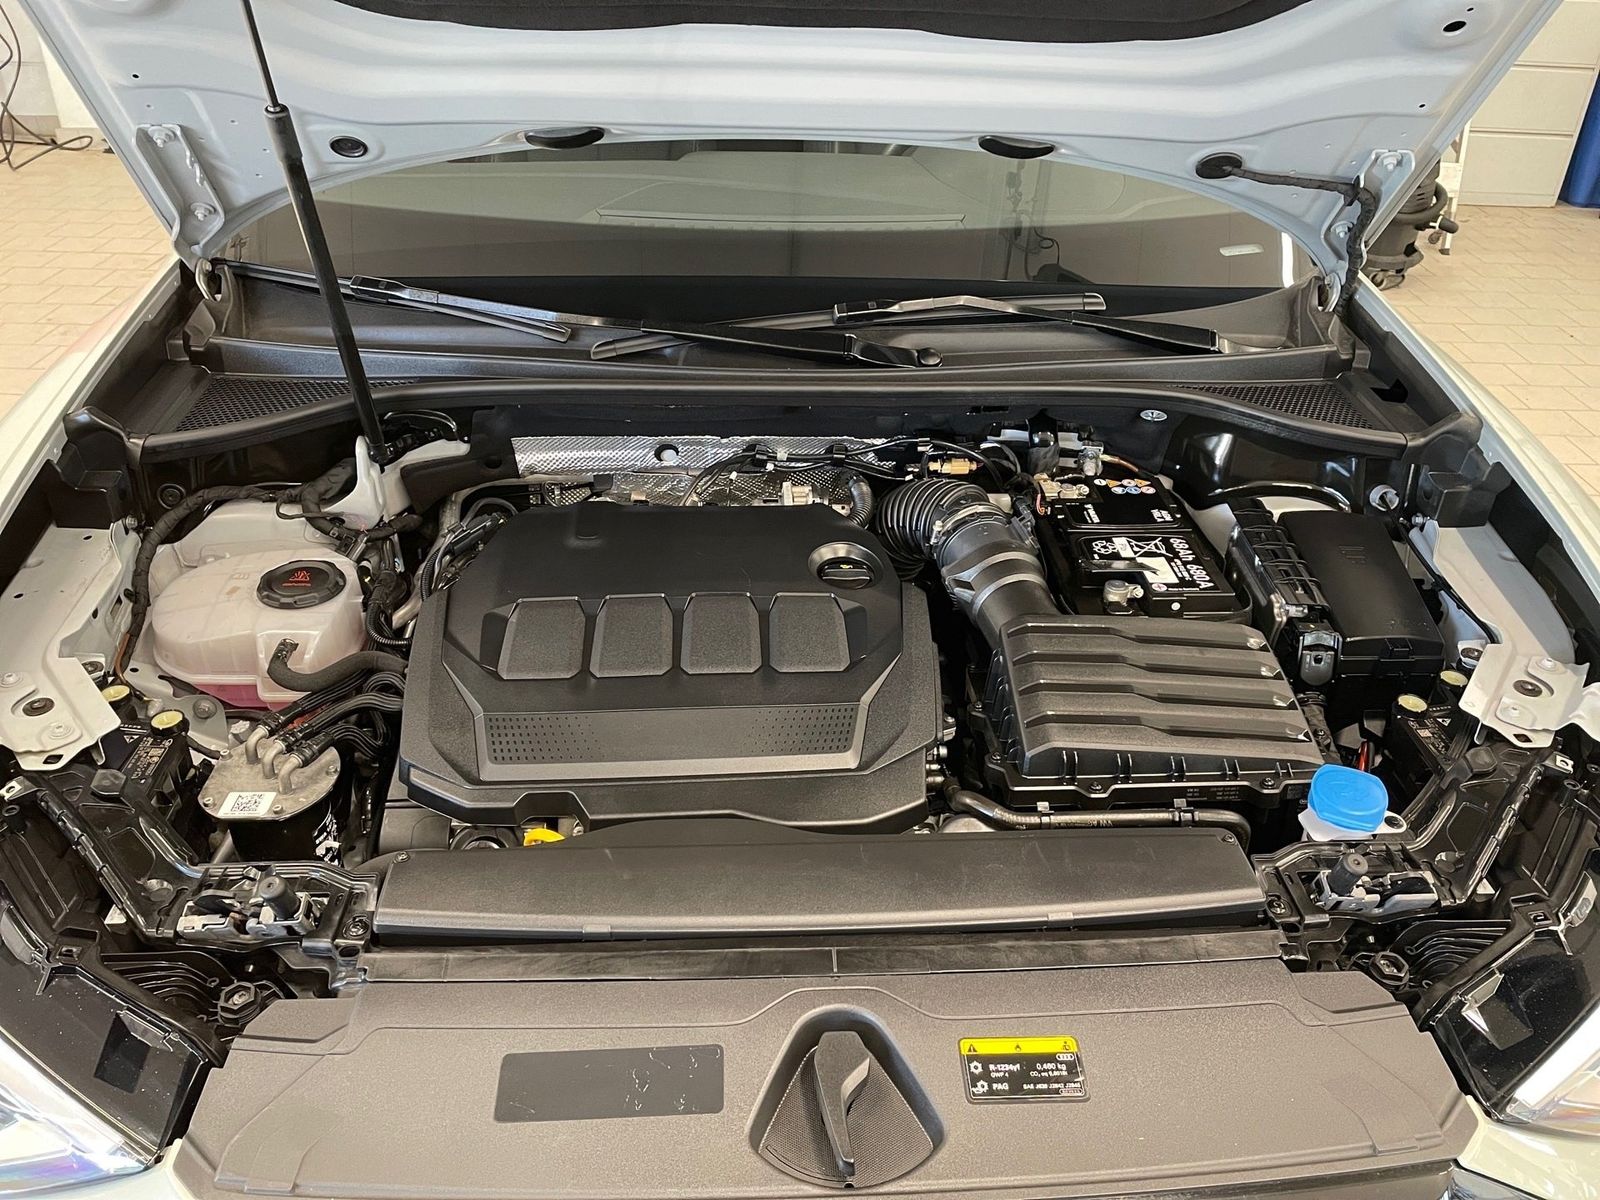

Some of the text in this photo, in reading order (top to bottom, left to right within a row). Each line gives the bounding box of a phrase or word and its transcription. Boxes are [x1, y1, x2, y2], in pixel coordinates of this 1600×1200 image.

[1169, 537, 1196, 561] 68Ah
[1186, 564, 1215, 589] 680A
[989, 1063, 1020, 1072] R-1234yf
[1057, 1063, 1067, 1071] kg
[992, 1082, 1009, 1090] PAG
